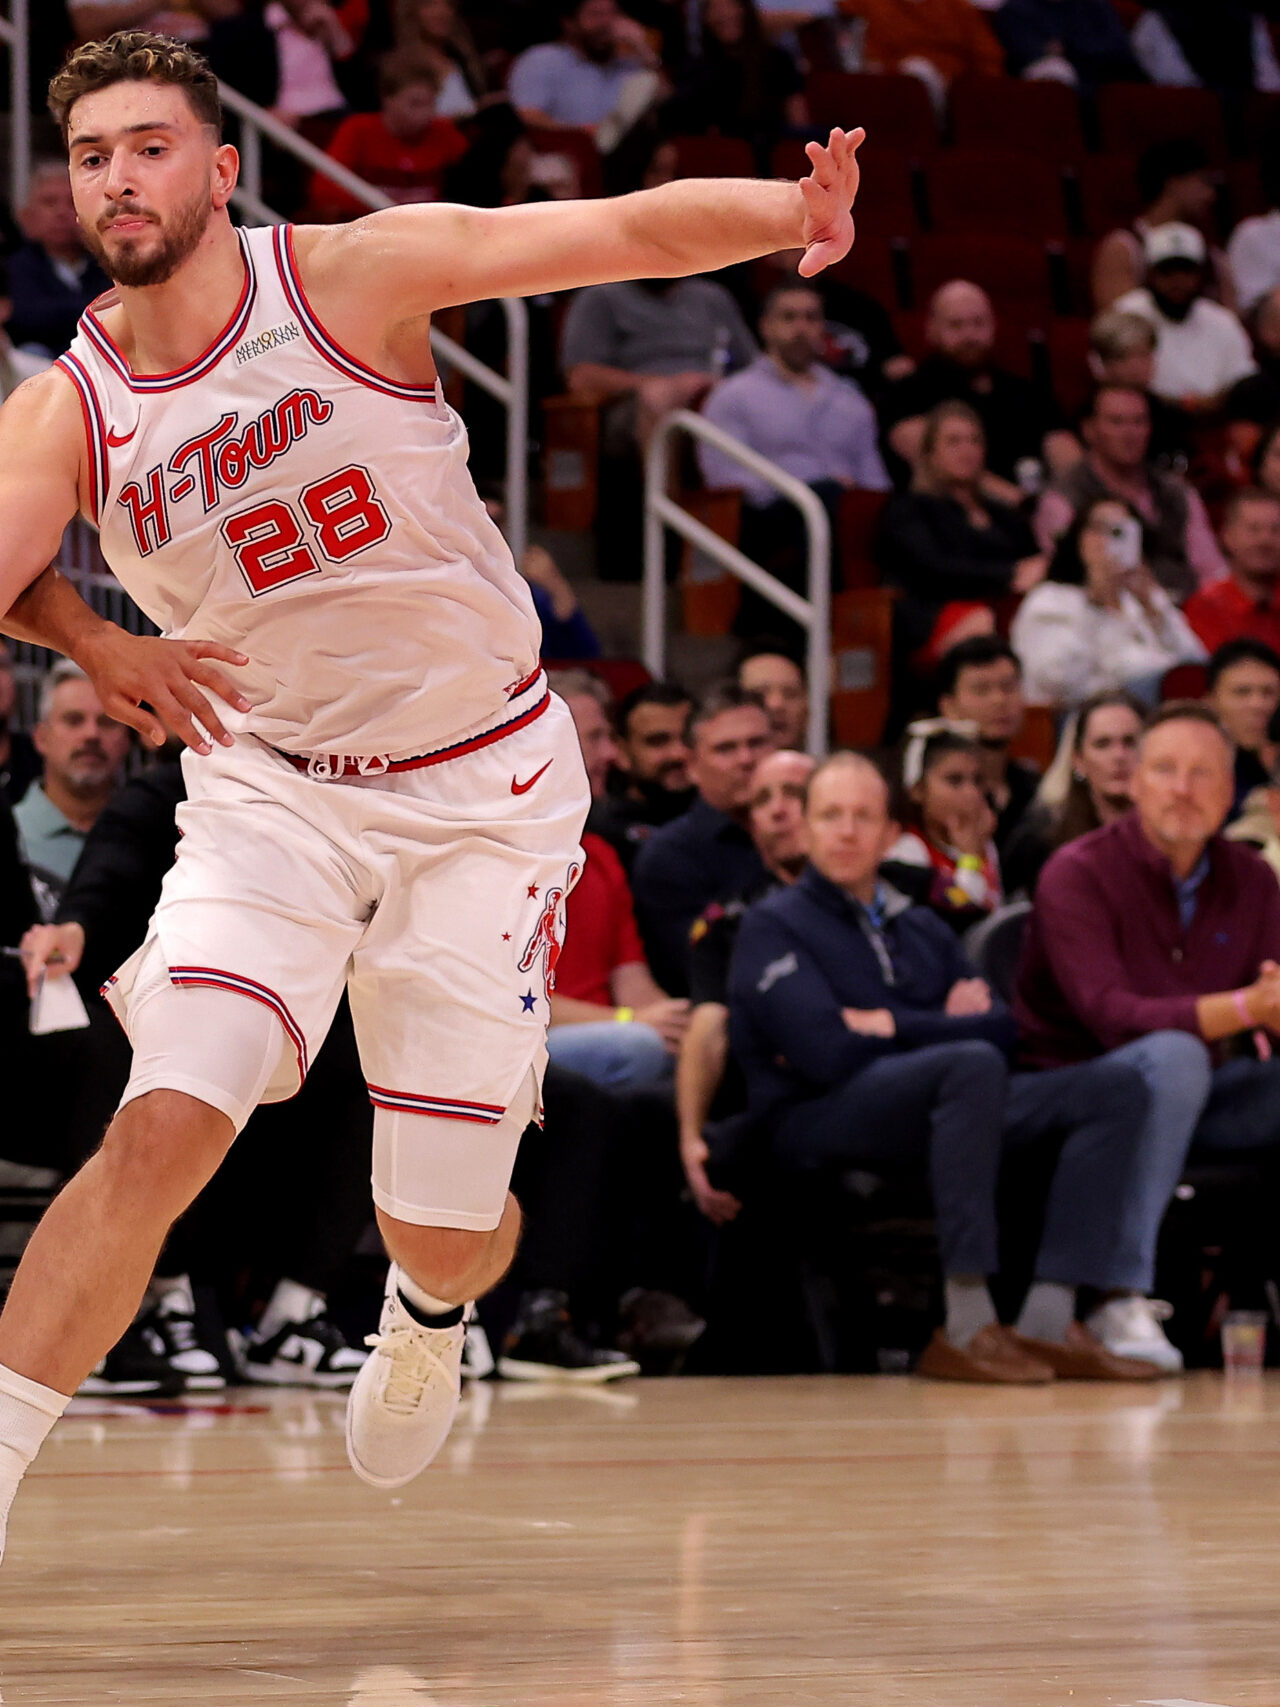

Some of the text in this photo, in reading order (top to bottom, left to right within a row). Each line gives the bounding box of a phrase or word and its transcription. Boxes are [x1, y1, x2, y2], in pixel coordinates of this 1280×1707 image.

[236, 322, 297, 355] MEMORIAL
[237, 328, 300, 365] HERMANN
[117, 388, 334, 558] H-Town
[220, 463, 392, 598] 28
